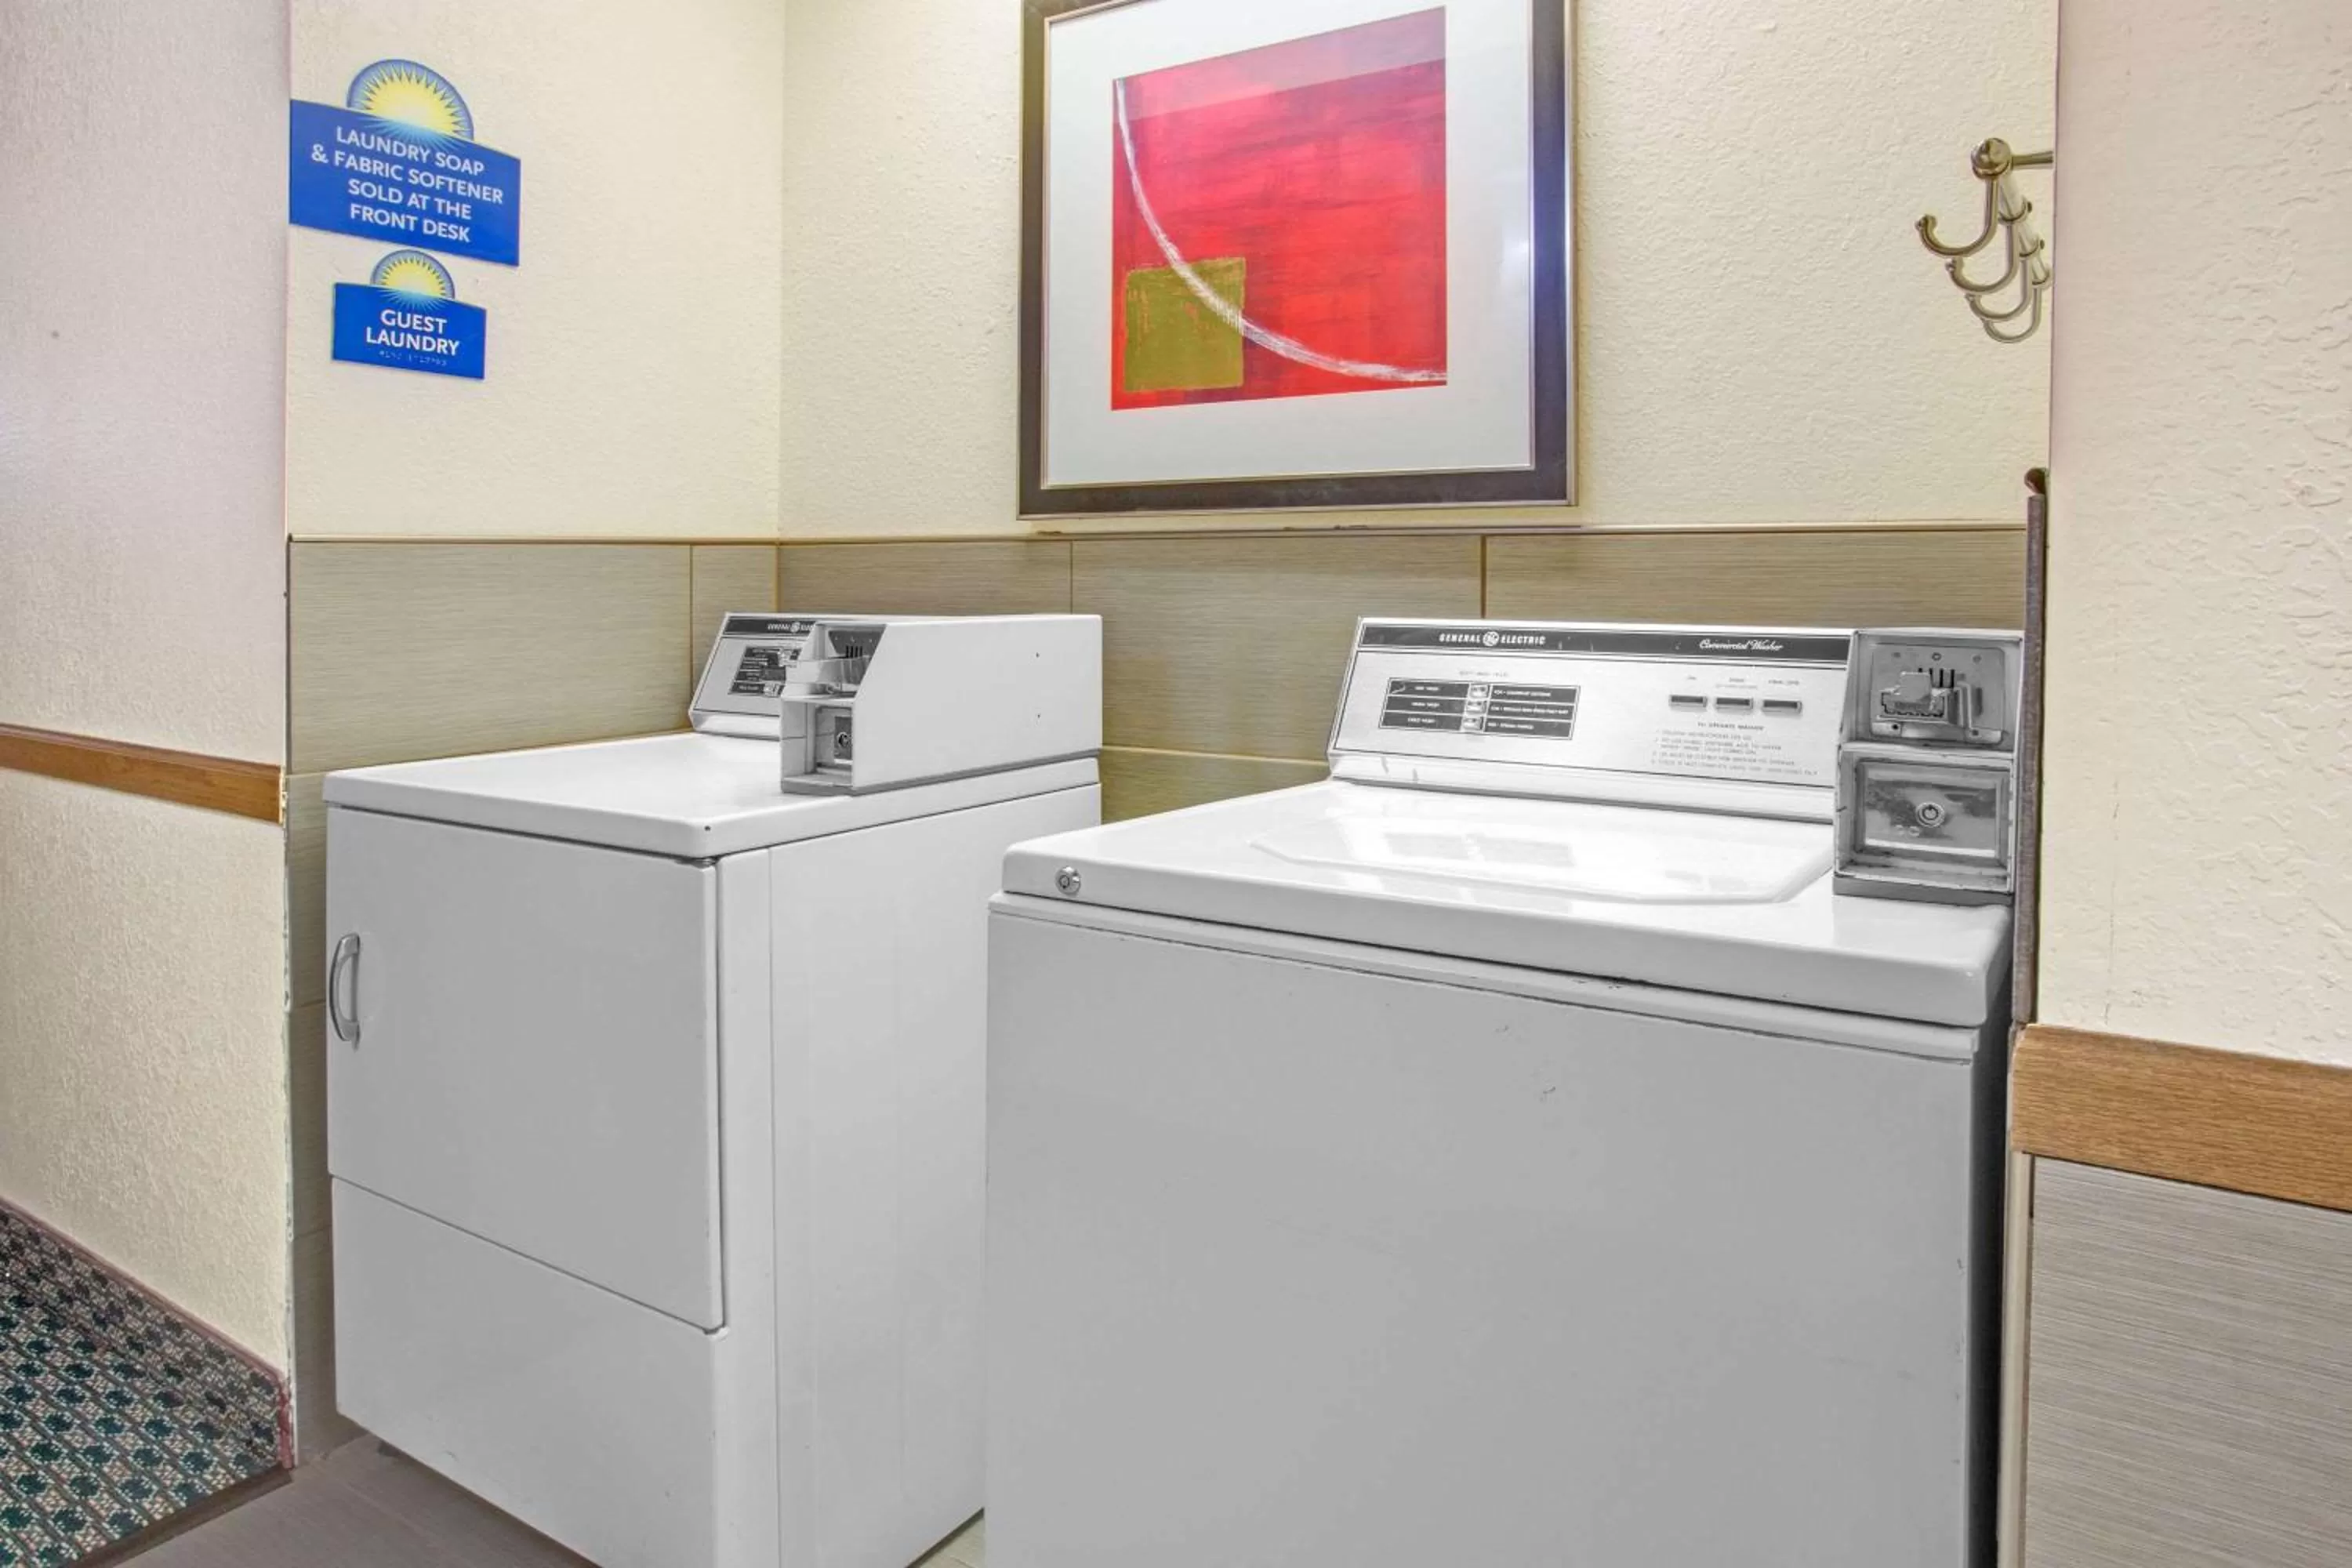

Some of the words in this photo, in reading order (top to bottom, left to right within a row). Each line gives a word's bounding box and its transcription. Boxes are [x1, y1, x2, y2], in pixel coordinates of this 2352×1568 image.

[336, 125, 430, 162] LAUNDRY
[435, 152, 485, 176] SOAP
[311, 144, 328, 163] &
[335, 151, 403, 181] FABRIC
[408, 169, 503, 205] SOFTENER
[348, 179, 403, 204] SOLD
[407, 194, 431, 210] AT
[434, 198, 472, 220] THE
[350, 204, 418, 232] FRONT
[423, 220, 470, 243] DESK
[380, 309, 447, 334] GUEST
[366, 327, 459, 356] LAUNDRY
[1438, 633, 1481, 643] GENERAL
[1501, 634, 1546, 644] ELECTRIC
